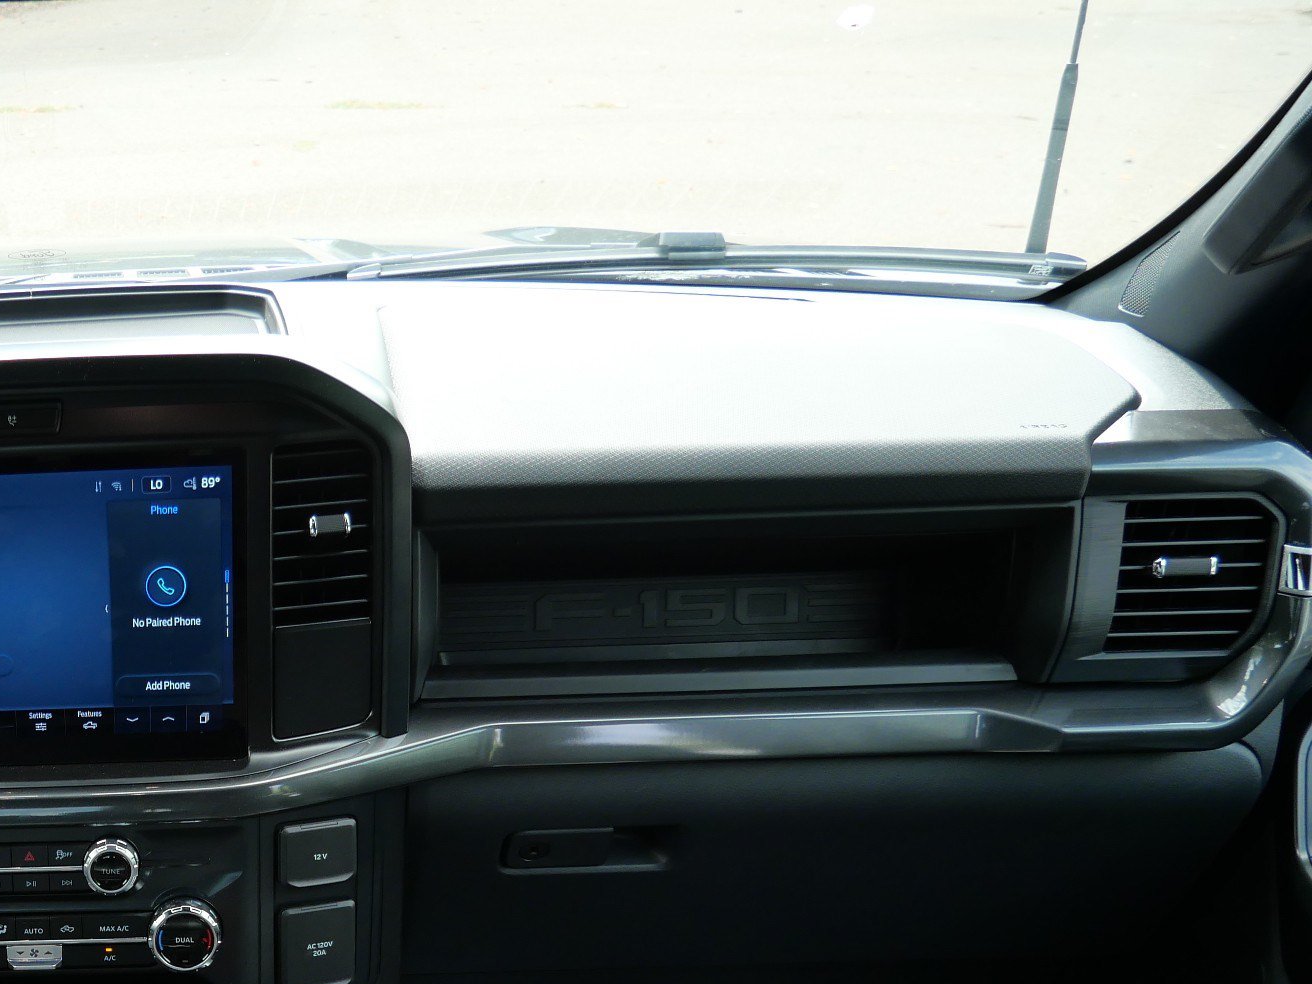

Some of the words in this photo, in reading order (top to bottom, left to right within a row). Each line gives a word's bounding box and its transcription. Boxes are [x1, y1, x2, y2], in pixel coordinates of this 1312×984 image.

[150, 479, 163, 490] LO
[150, 505, 178, 515] Phone
[132, 618, 145, 628] No
[146, 616, 173, 628] Paired
[174, 616, 201, 627] Phone
[145, 681, 163, 691] Add
[163, 680, 191, 690] Phone
[28, 712, 53, 720] Settings
[77, 710, 102, 718] Features
[306, 943, 317, 951] AC
[317, 941, 333, 949] 120V
[312, 949, 327, 957] 20A
